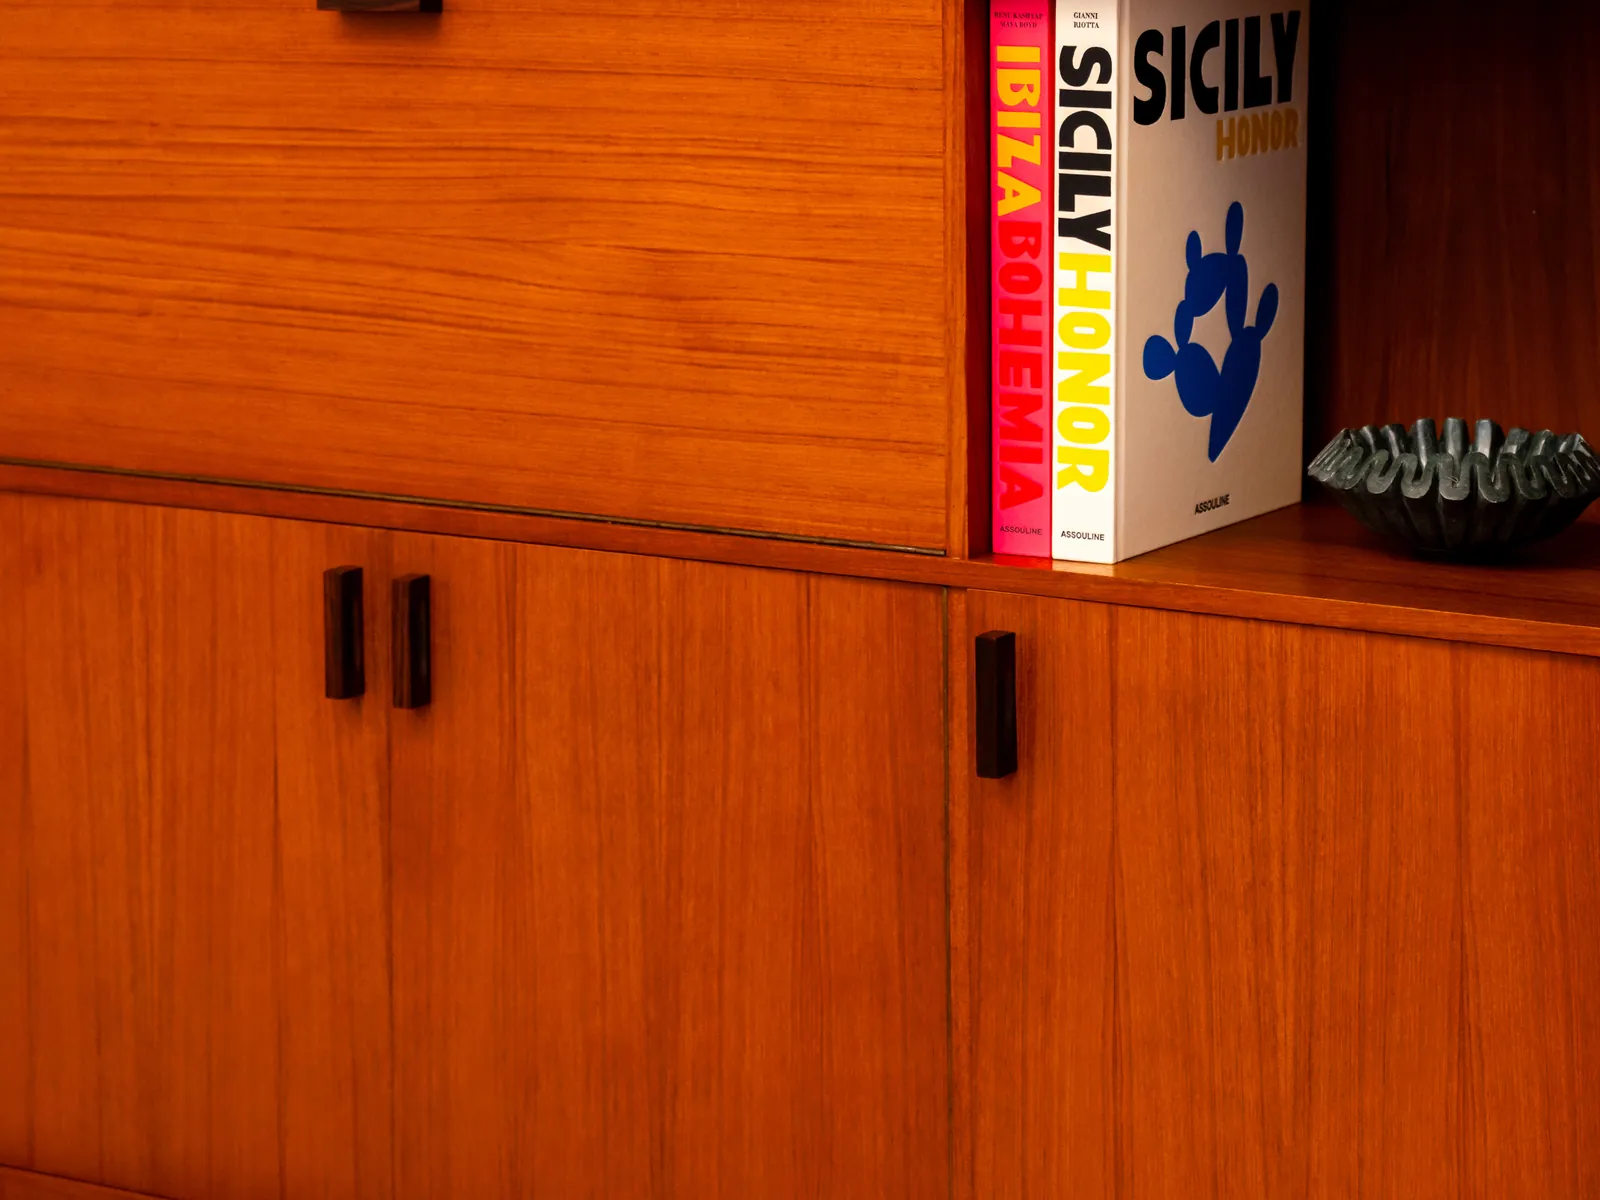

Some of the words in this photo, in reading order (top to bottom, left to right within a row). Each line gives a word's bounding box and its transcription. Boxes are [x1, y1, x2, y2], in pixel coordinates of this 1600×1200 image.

[1019, 21, 1038, 29] BOYD
[1073, 11, 1098, 20] GIANNI
[1073, 21, 1100, 29] RIOTTA
[1133, 10, 1301, 126] SICILY
[996, 45, 1042, 217] IBIZA
[1058, 45, 1112, 252] SICILY
[1216, 107, 1299, 161] HONOR
[998, 220, 1044, 511] BOHEMIA
[1056, 252, 1112, 493] HONOR
[1194, 493, 1231, 516] ASSOULINE
[999, 525, 1043, 536] ASSOULINE
[1060, 530, 1105, 541] ASSOULINE
